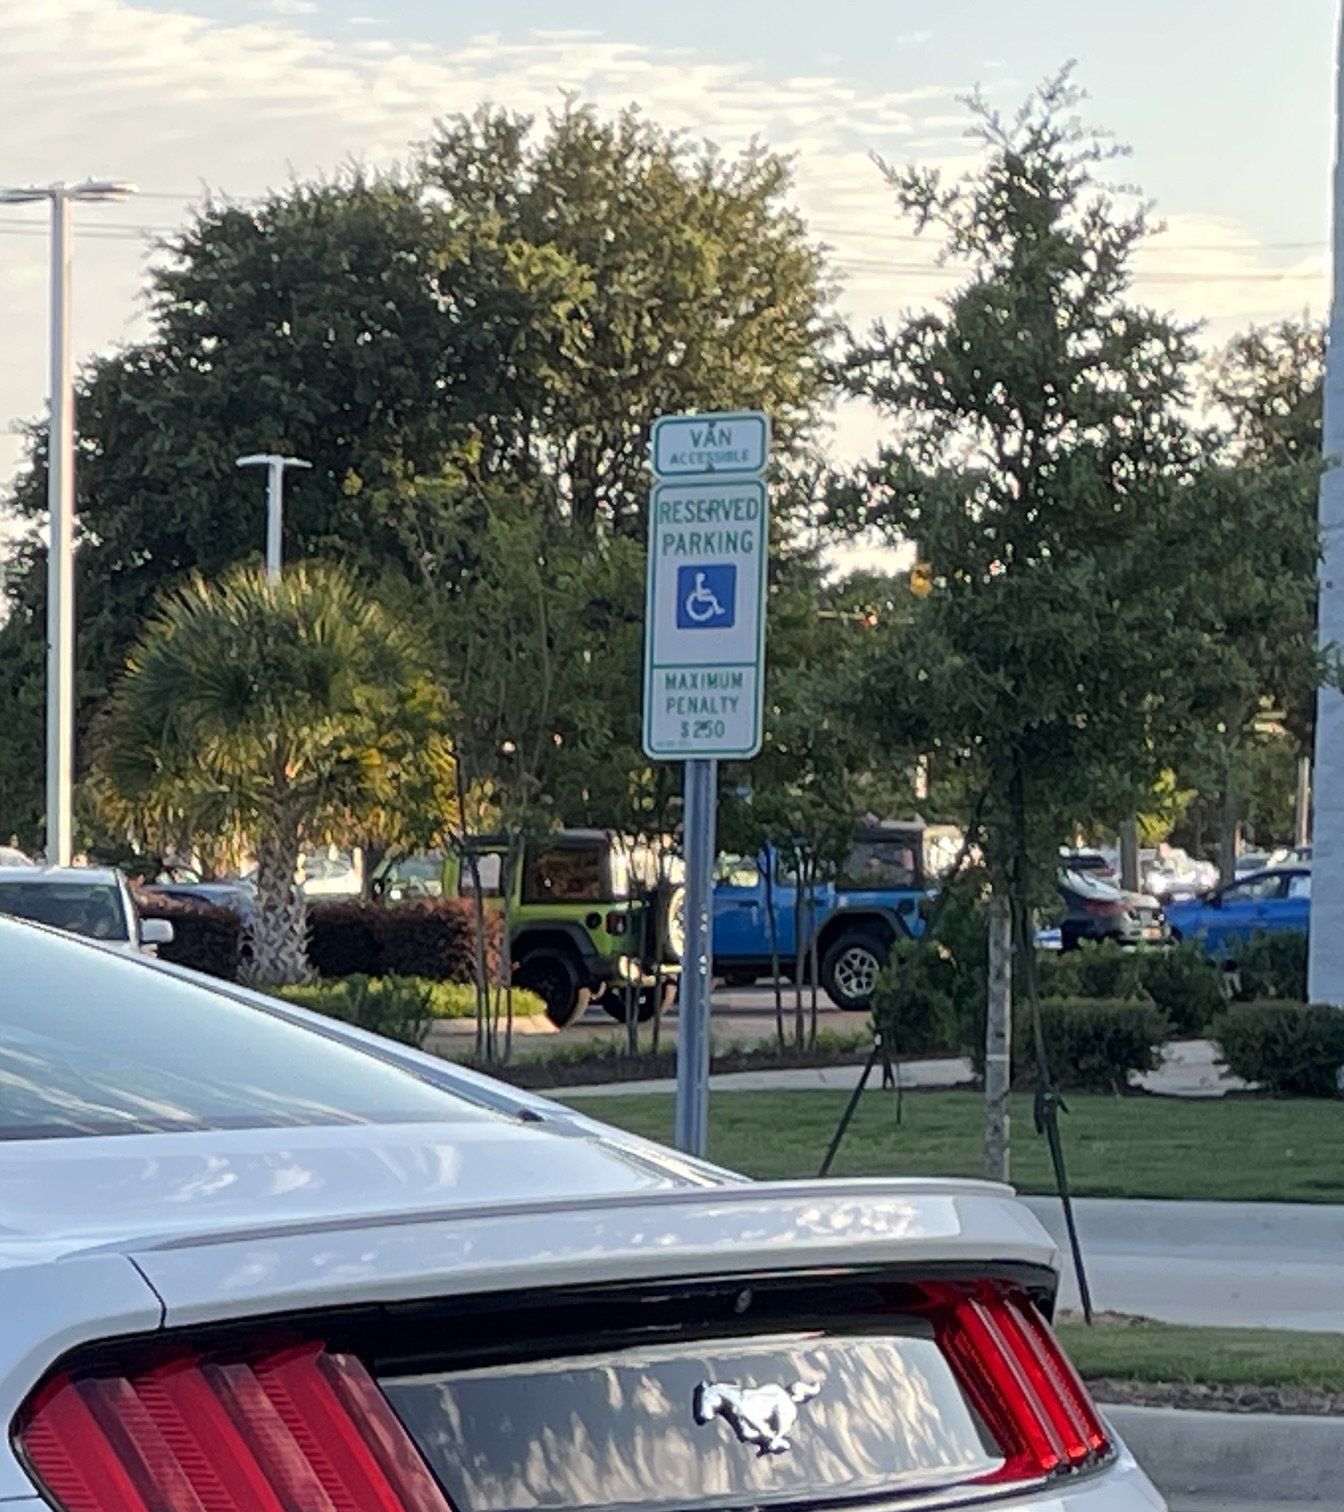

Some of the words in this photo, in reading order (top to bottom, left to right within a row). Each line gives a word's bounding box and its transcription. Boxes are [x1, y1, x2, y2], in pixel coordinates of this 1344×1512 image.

[690, 428, 732, 448] VAN
[669, 449, 749, 465] ACCESSIBLE
[658, 498, 759, 524] RESERVED
[663, 530, 753, 556] PARKING
[665, 672, 743, 690] MAXIMUM
[665, 696, 739, 714] PENALTY
[681, 720, 725, 739] $250
